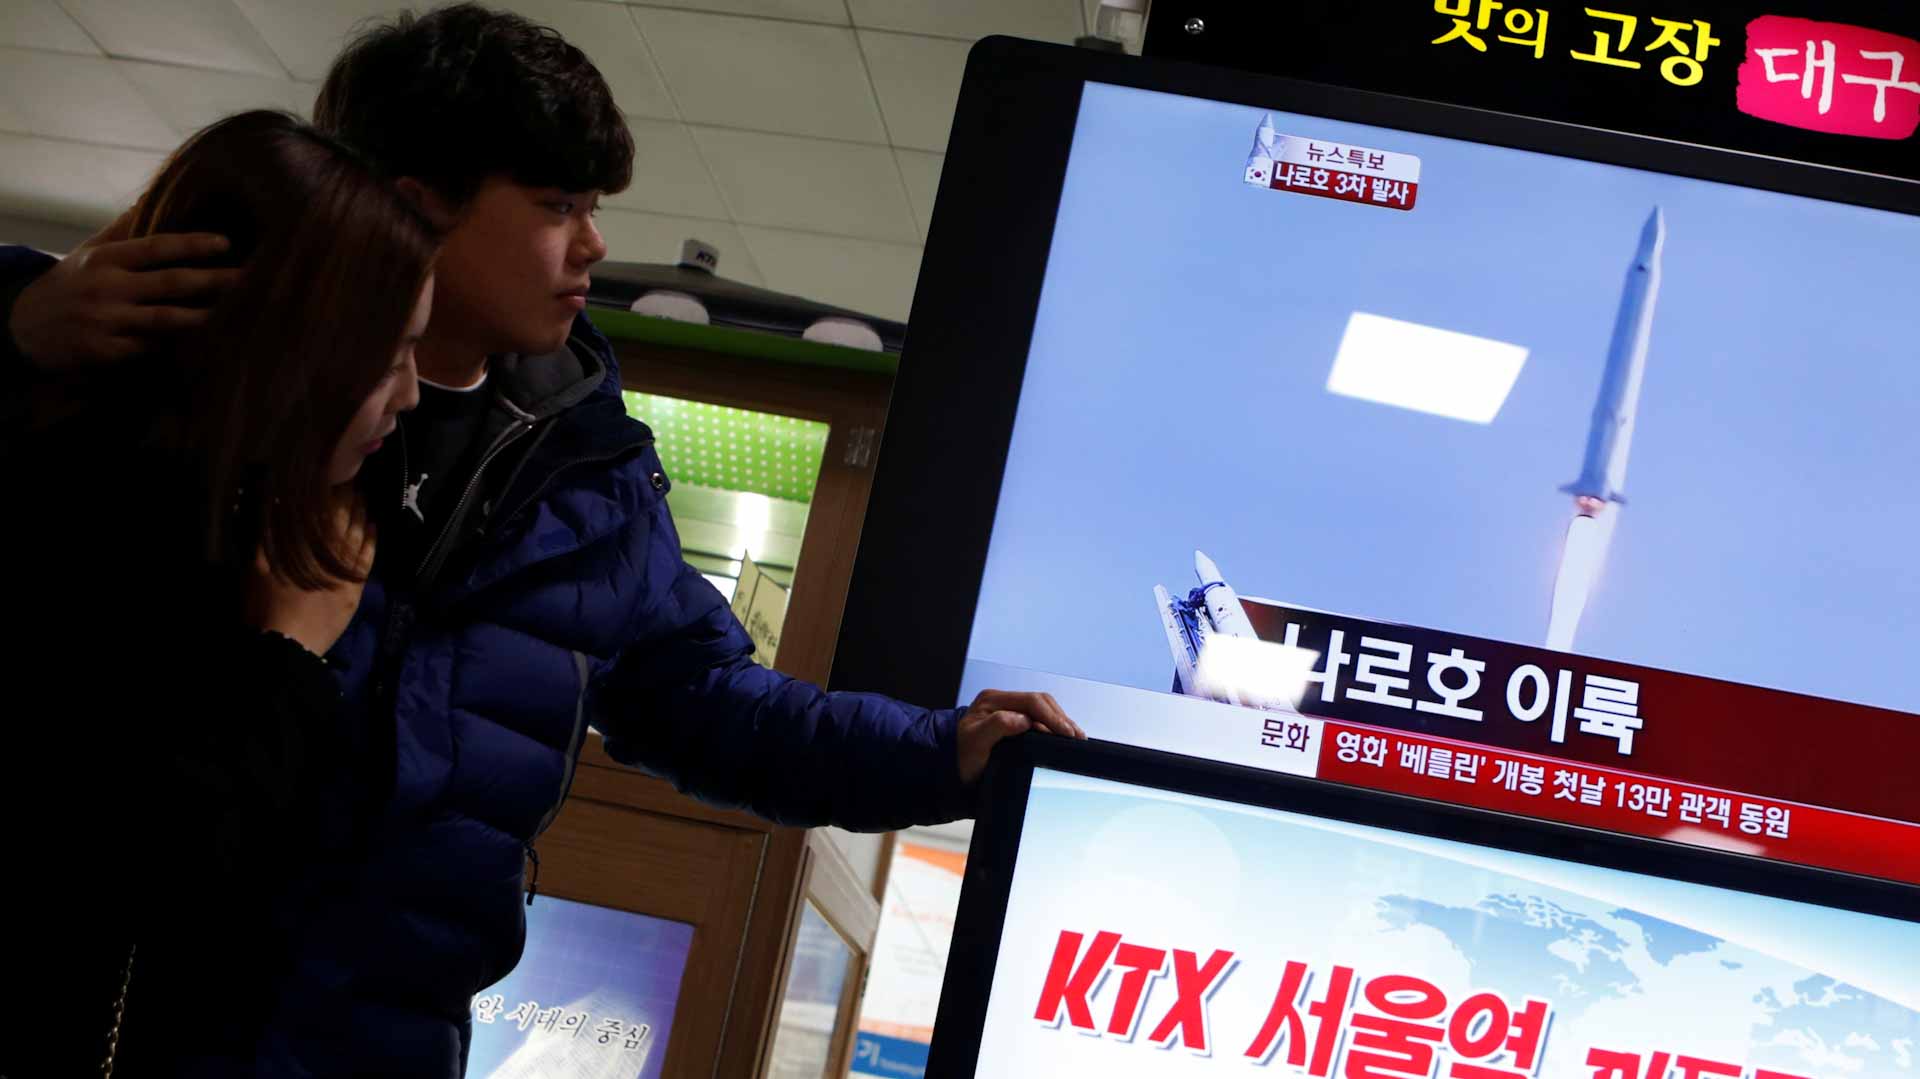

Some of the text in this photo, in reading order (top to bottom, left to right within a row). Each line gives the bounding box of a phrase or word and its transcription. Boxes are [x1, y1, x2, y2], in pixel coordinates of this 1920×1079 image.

[1570, 8, 1720, 86] 고장
[1755, 40, 1920, 123] 대구
[1275, 163, 1409, 205] 나로호 3차 발사
[1306, 143, 1384, 171] 뉴스특보
[1260, 718, 1310, 753] 문화
[1506, 664, 1644, 755] 이륙
[1336, 731, 1790, 840] 영화 '베를린' 개봉 첫날 13만 관객 동원
[508, 1003, 586, 1038] 시대의
[597, 1019, 648, 1050] 중심
[1033, 929, 1235, 1051] KTX
